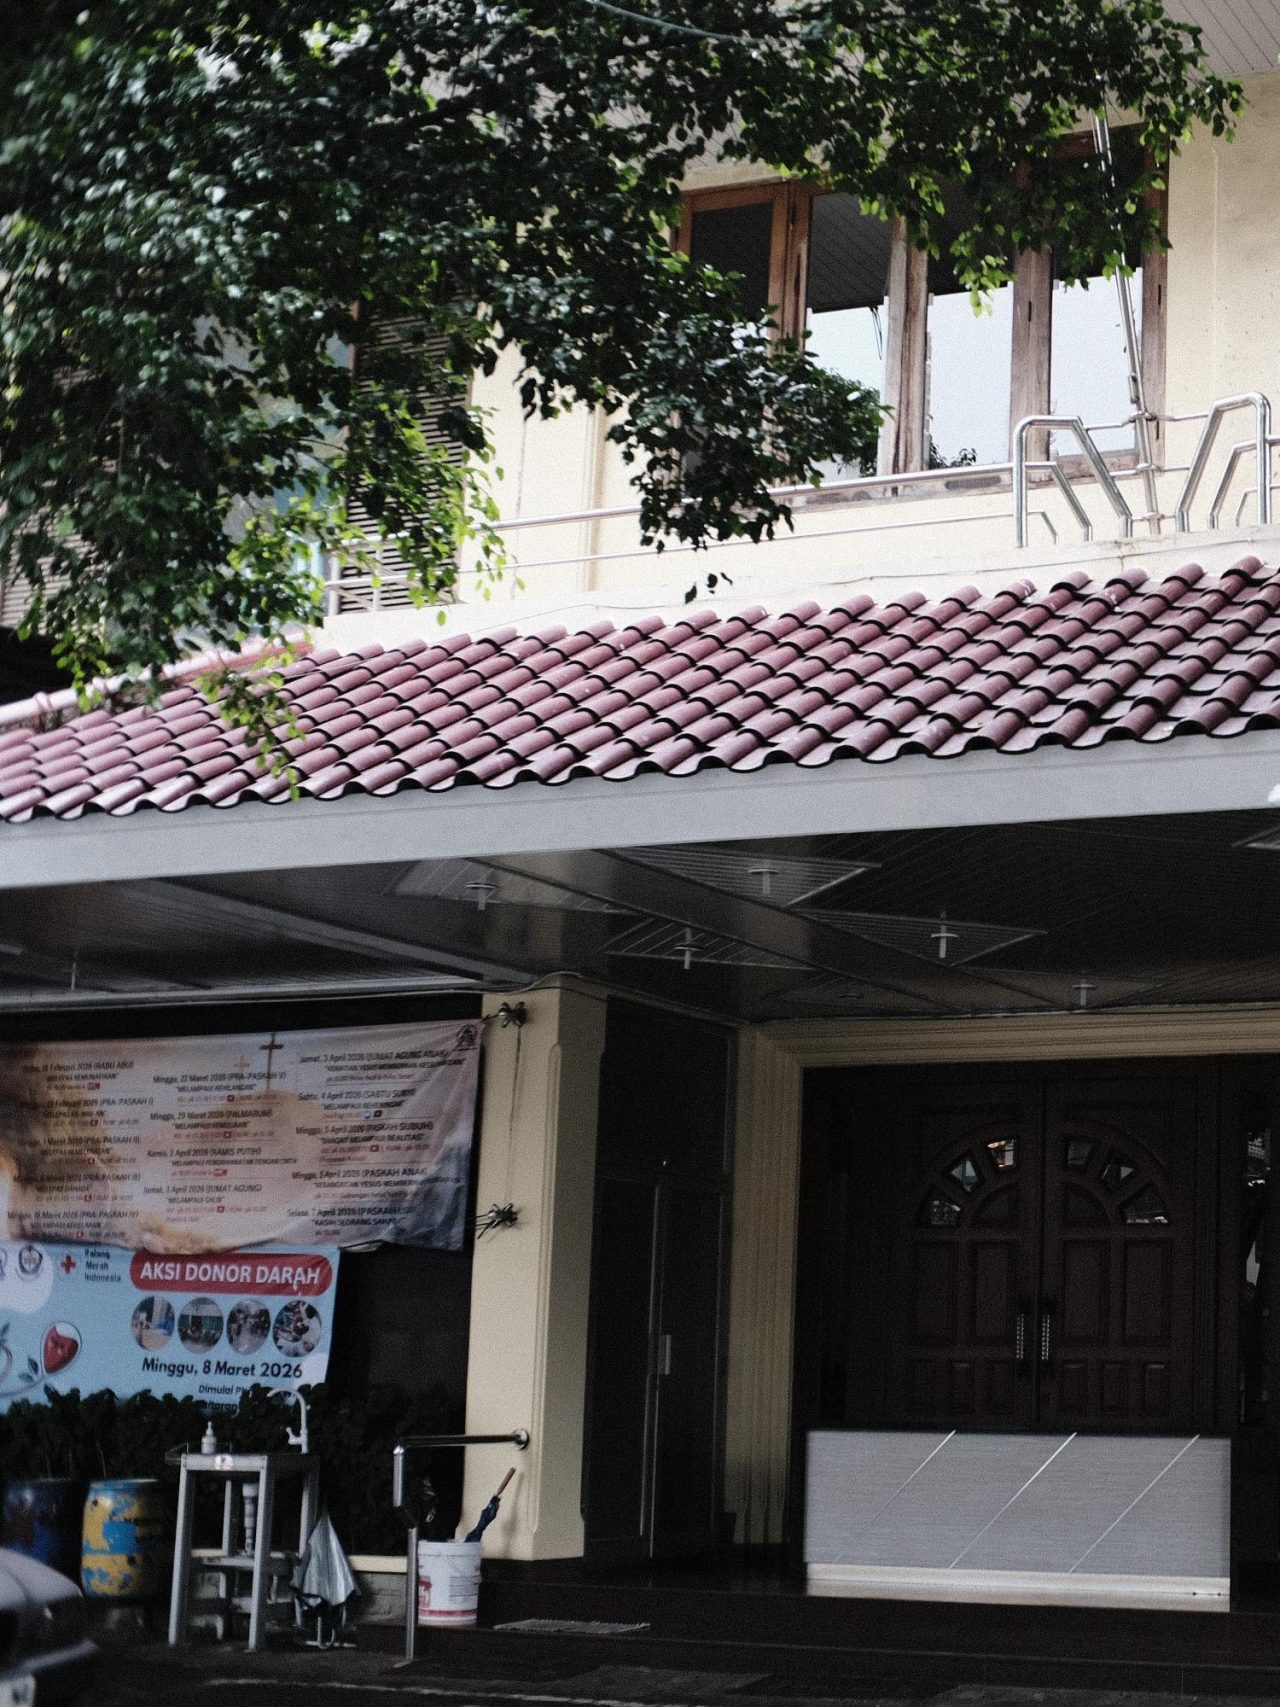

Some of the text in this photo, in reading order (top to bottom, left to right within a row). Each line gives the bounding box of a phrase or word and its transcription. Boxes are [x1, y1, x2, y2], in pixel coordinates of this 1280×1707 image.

[329, 1053, 346, 1063] April
[347, 1052, 365, 1061] 2026
[327, 1090, 344, 1101] April
[330, 1123, 348, 1134] April
[175, 1147, 191, 1158] April
[192, 1147, 208, 1157] 2026
[171, 1185, 187, 1195] April
[188, 1184, 204, 1194] 2026
[317, 1207, 336, 1218] April
[85, 1261, 109, 1270] Merah
[84, 1273, 121, 1283] Indonesia
[140, 1262, 321, 1285] AKSI DONOR DARAH
[142, 1357, 303, 1378] Minggu, 8 Maret 2026
[198, 1384, 234, 1395] Dimulai
